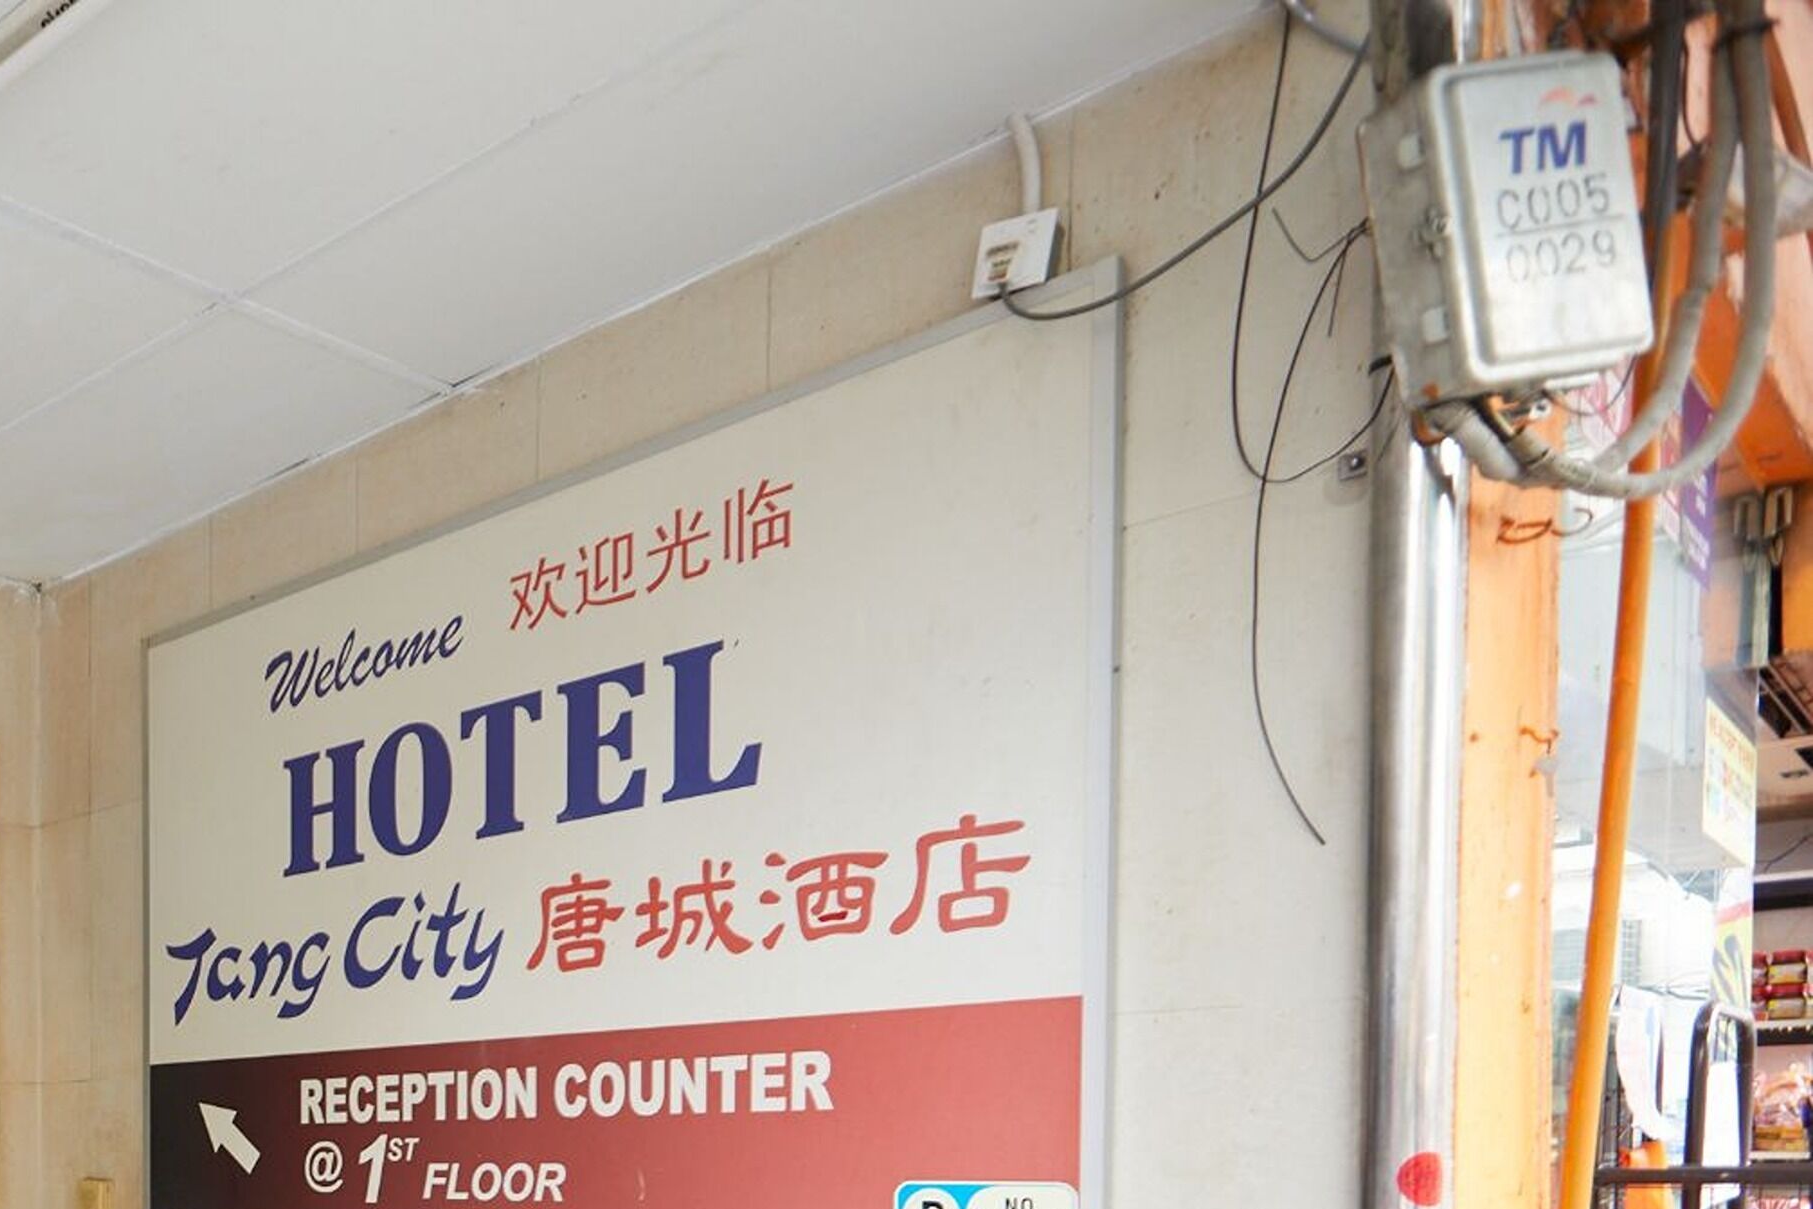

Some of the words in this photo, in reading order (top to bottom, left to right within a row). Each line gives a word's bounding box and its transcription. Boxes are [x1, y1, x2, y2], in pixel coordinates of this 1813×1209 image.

[1499, 121, 1586, 174] TM
[1498, 173, 1611, 229] C005
[509, 478, 795, 630] 欢迎光临
[264, 615, 464, 714] Welcome
[283, 639, 763, 878] HOTEL
[526, 814, 1031, 973] 唐城酒店
[165, 928, 331, 1027] Tang
[344, 882, 504, 1000] City
[300, 1066, 538, 1125] RECEPTION
[554, 1050, 834, 1118] COUNTER
[304, 1141, 344, 1193] @
[422, 1162, 567, 1202] FLOOR
